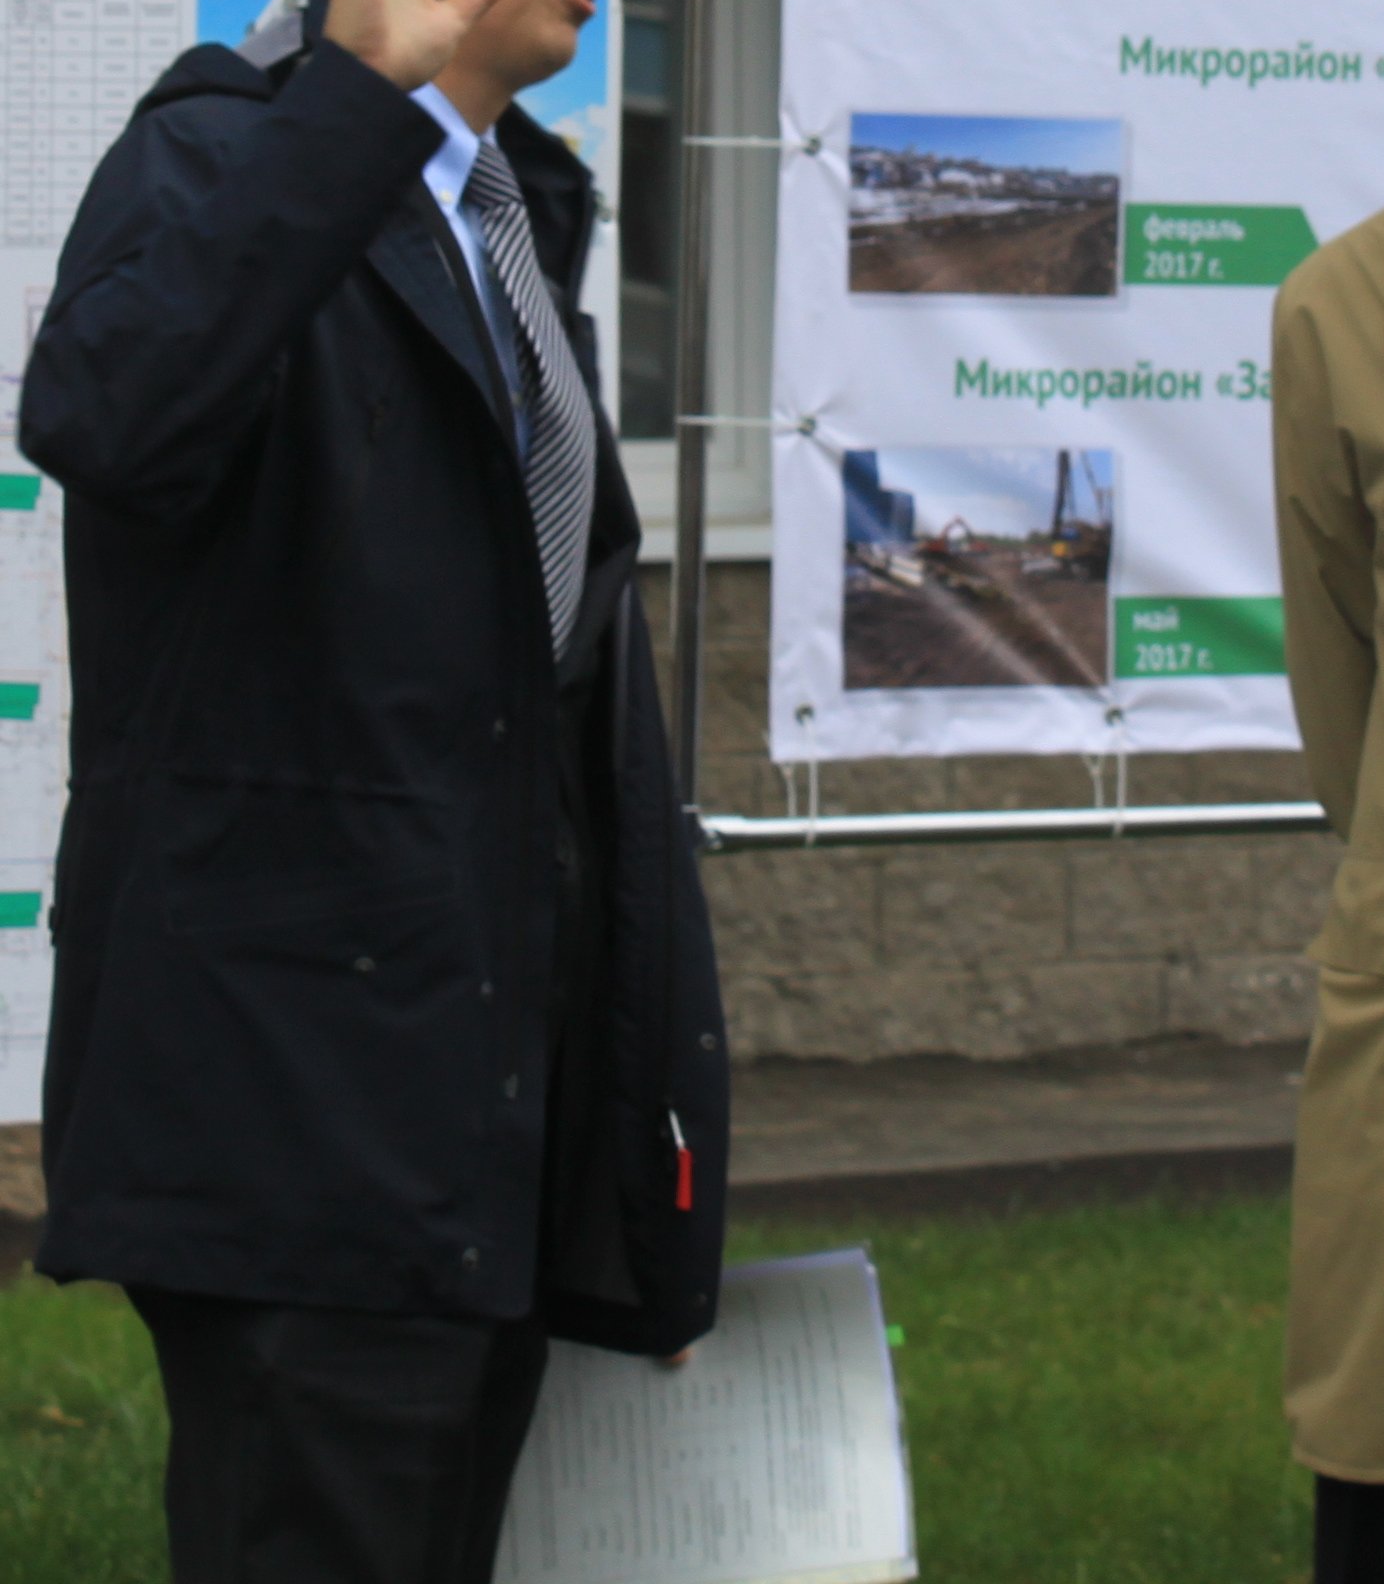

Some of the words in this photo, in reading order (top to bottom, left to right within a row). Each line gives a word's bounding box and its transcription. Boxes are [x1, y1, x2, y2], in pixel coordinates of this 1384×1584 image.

[1119, 34, 1363, 89] Микрорайон
[1143, 214, 1245, 243] февраль
[1143, 251, 1206, 280] 2017
[954, 358, 1201, 409] Микрорайон
[1215, 361, 1273, 400] «За
[1133, 606, 1180, 630] май
[1135, 644, 1193, 672] 2017
